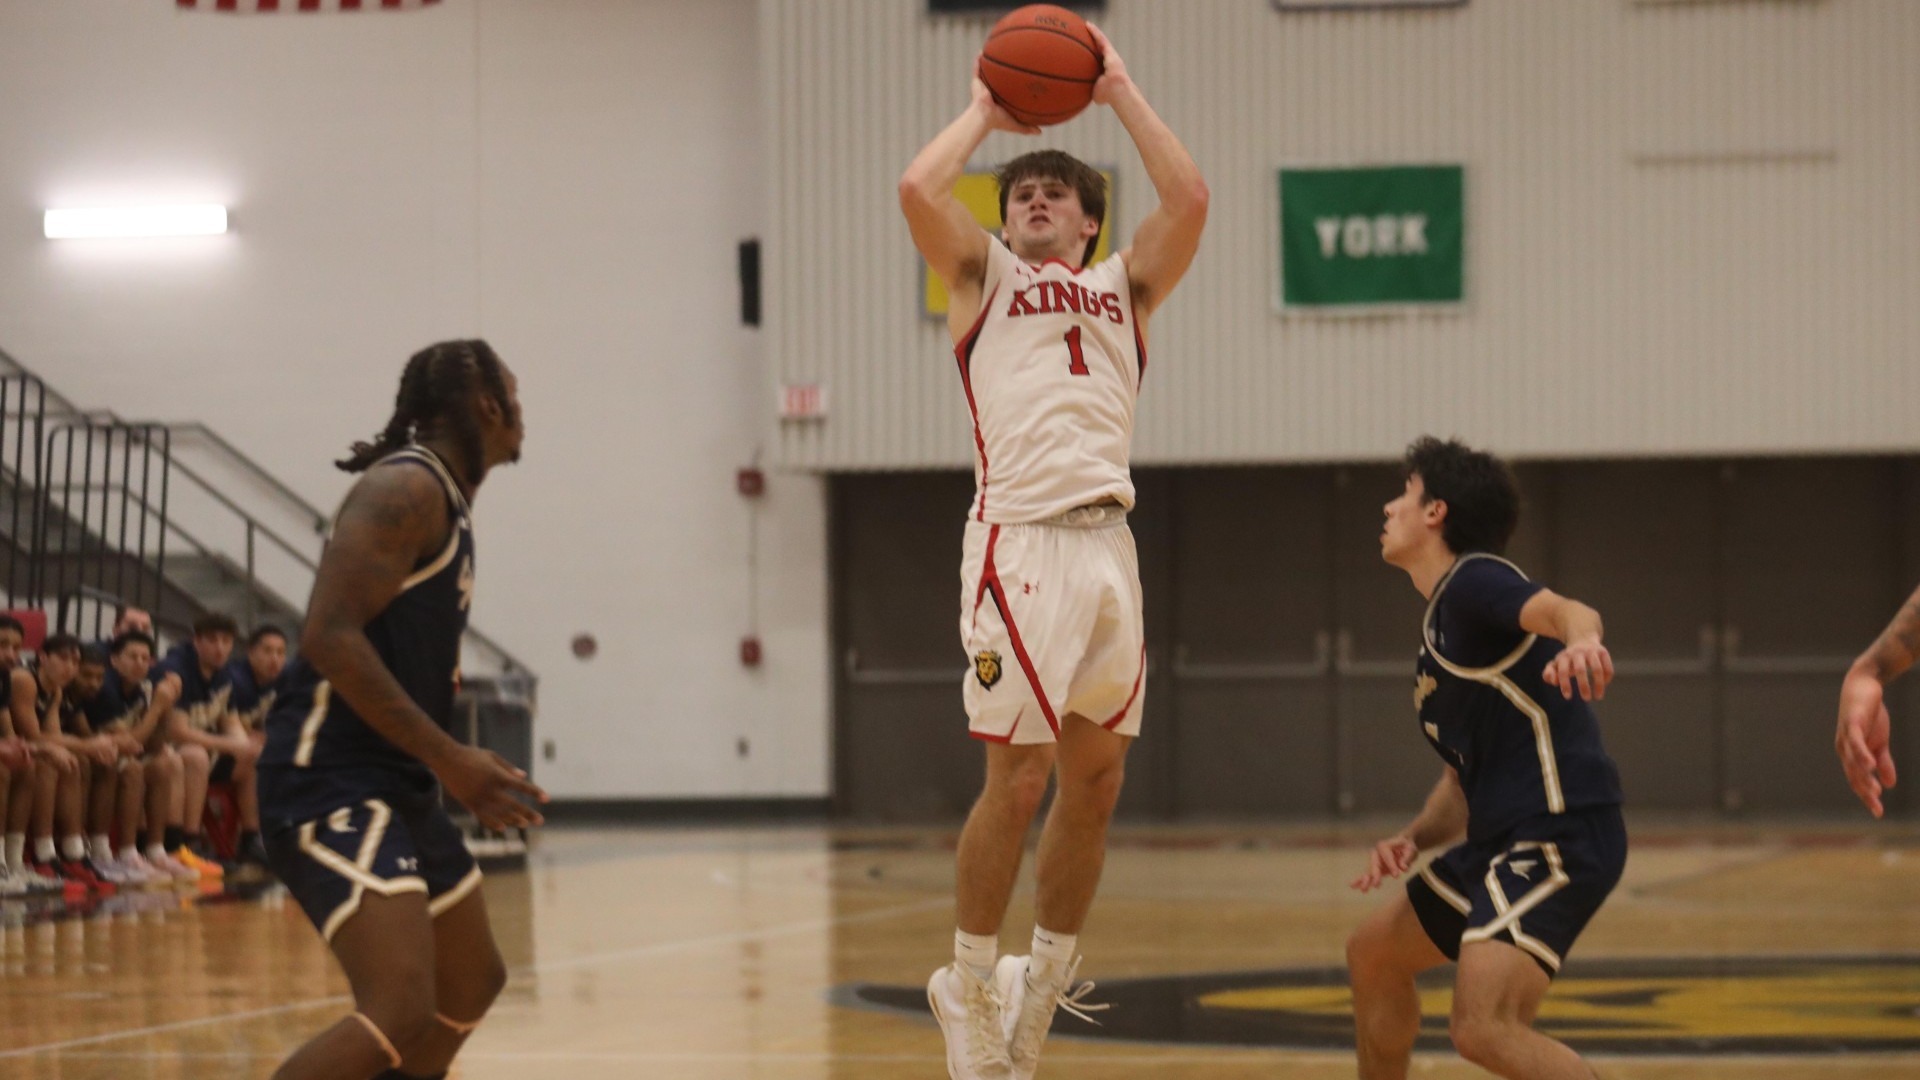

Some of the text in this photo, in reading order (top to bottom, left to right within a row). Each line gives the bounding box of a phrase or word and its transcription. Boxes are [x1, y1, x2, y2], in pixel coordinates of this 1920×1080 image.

[1314, 213, 1428, 258] YORK
[1007, 280, 1124, 325] KINGS
[1064, 325, 1091, 376] 1
